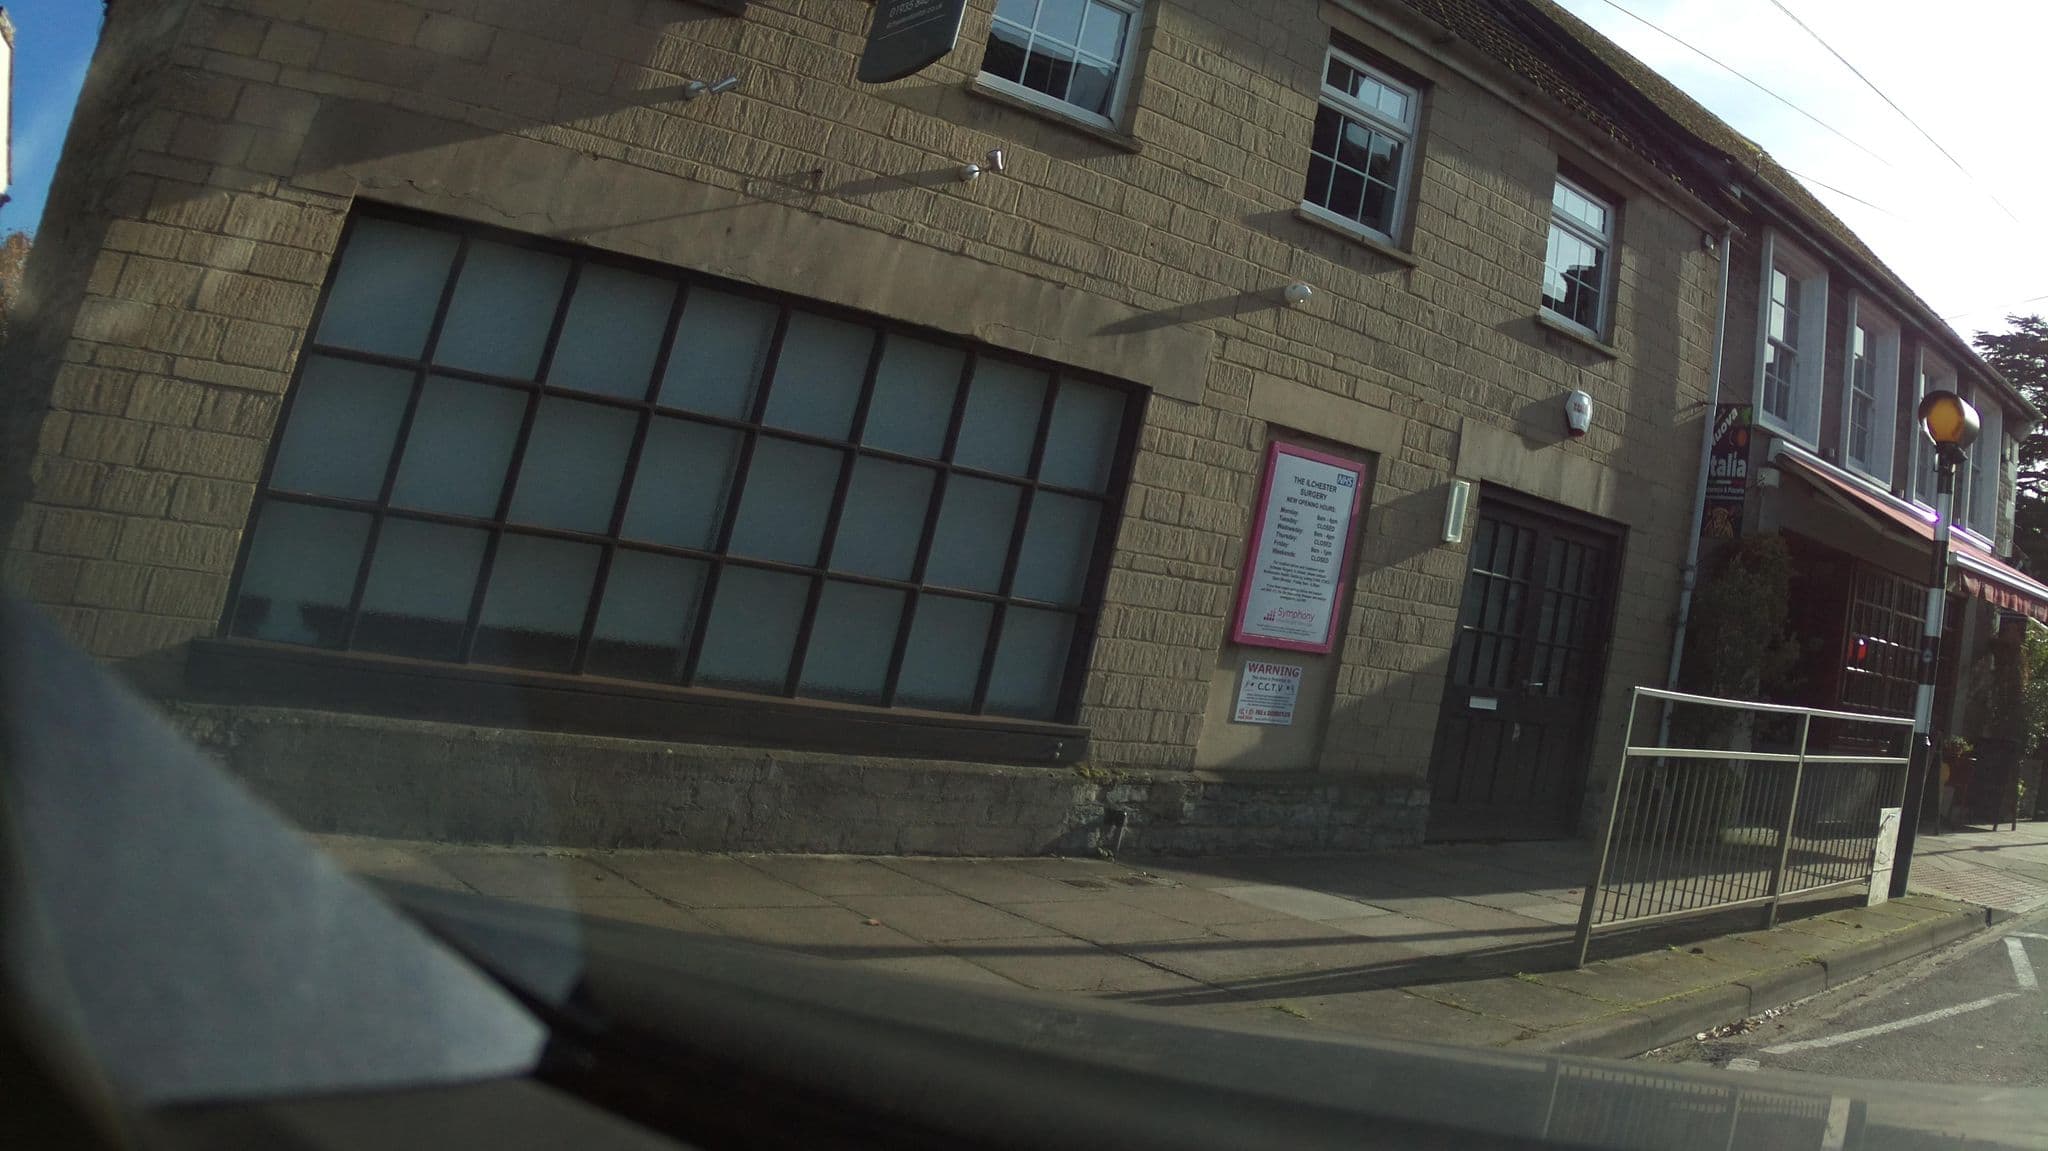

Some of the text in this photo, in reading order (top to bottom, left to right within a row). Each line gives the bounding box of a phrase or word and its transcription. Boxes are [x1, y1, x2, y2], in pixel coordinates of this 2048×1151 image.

[1294, 476, 1337, 493] THE ILCHESTER
[1300, 489, 1327, 500] SURGERY
[1278, 607, 1315, 622] Symphony
[1248, 662, 1301, 678] WARNING
